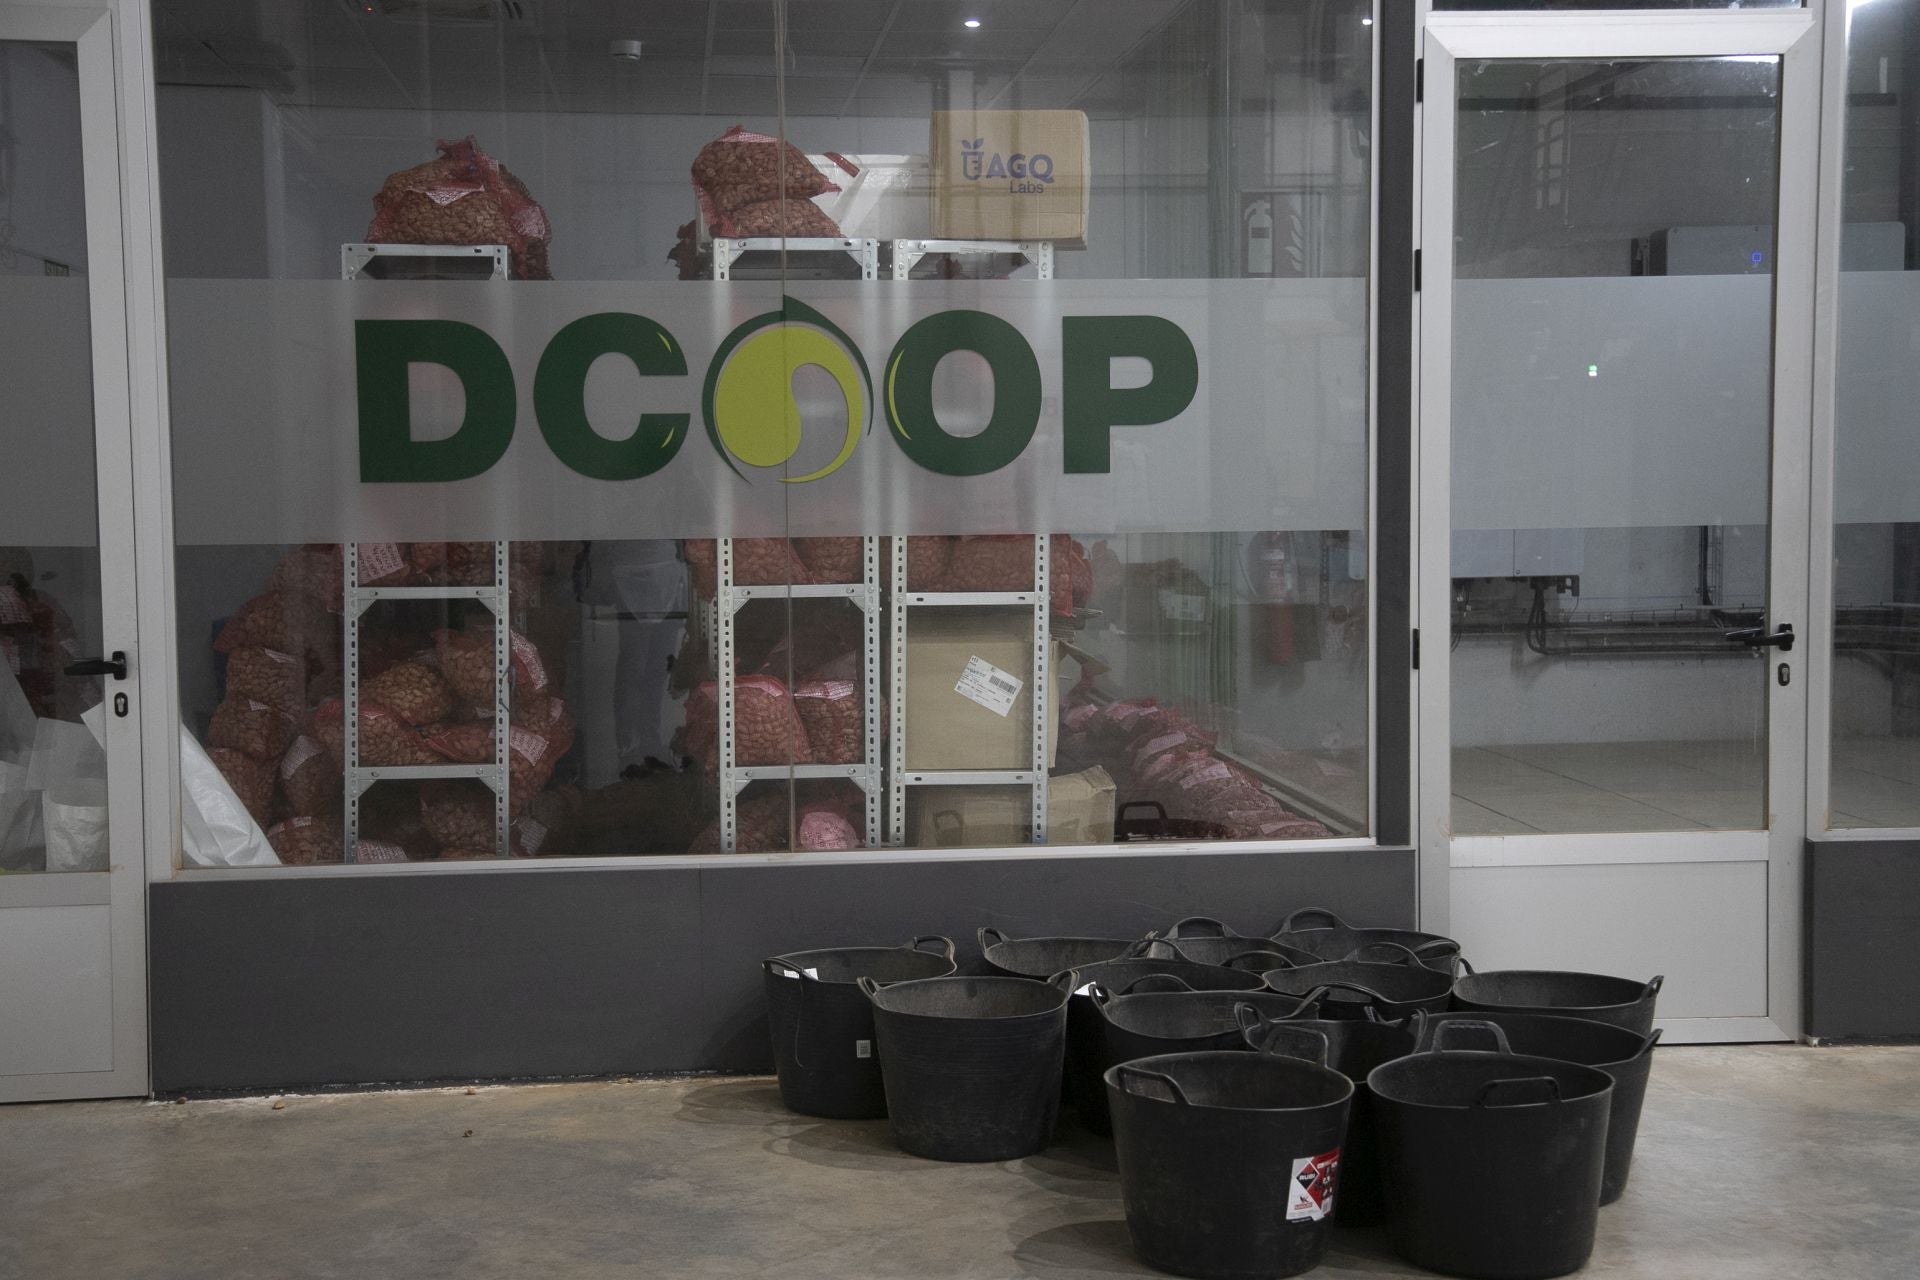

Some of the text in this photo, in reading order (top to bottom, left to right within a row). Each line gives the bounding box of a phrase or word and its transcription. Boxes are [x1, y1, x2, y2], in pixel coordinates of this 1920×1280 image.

[986, 153, 1054, 183] AGQ
[1009, 181, 1044, 194] Labs
[355, 296, 1198, 484] DCOOP
